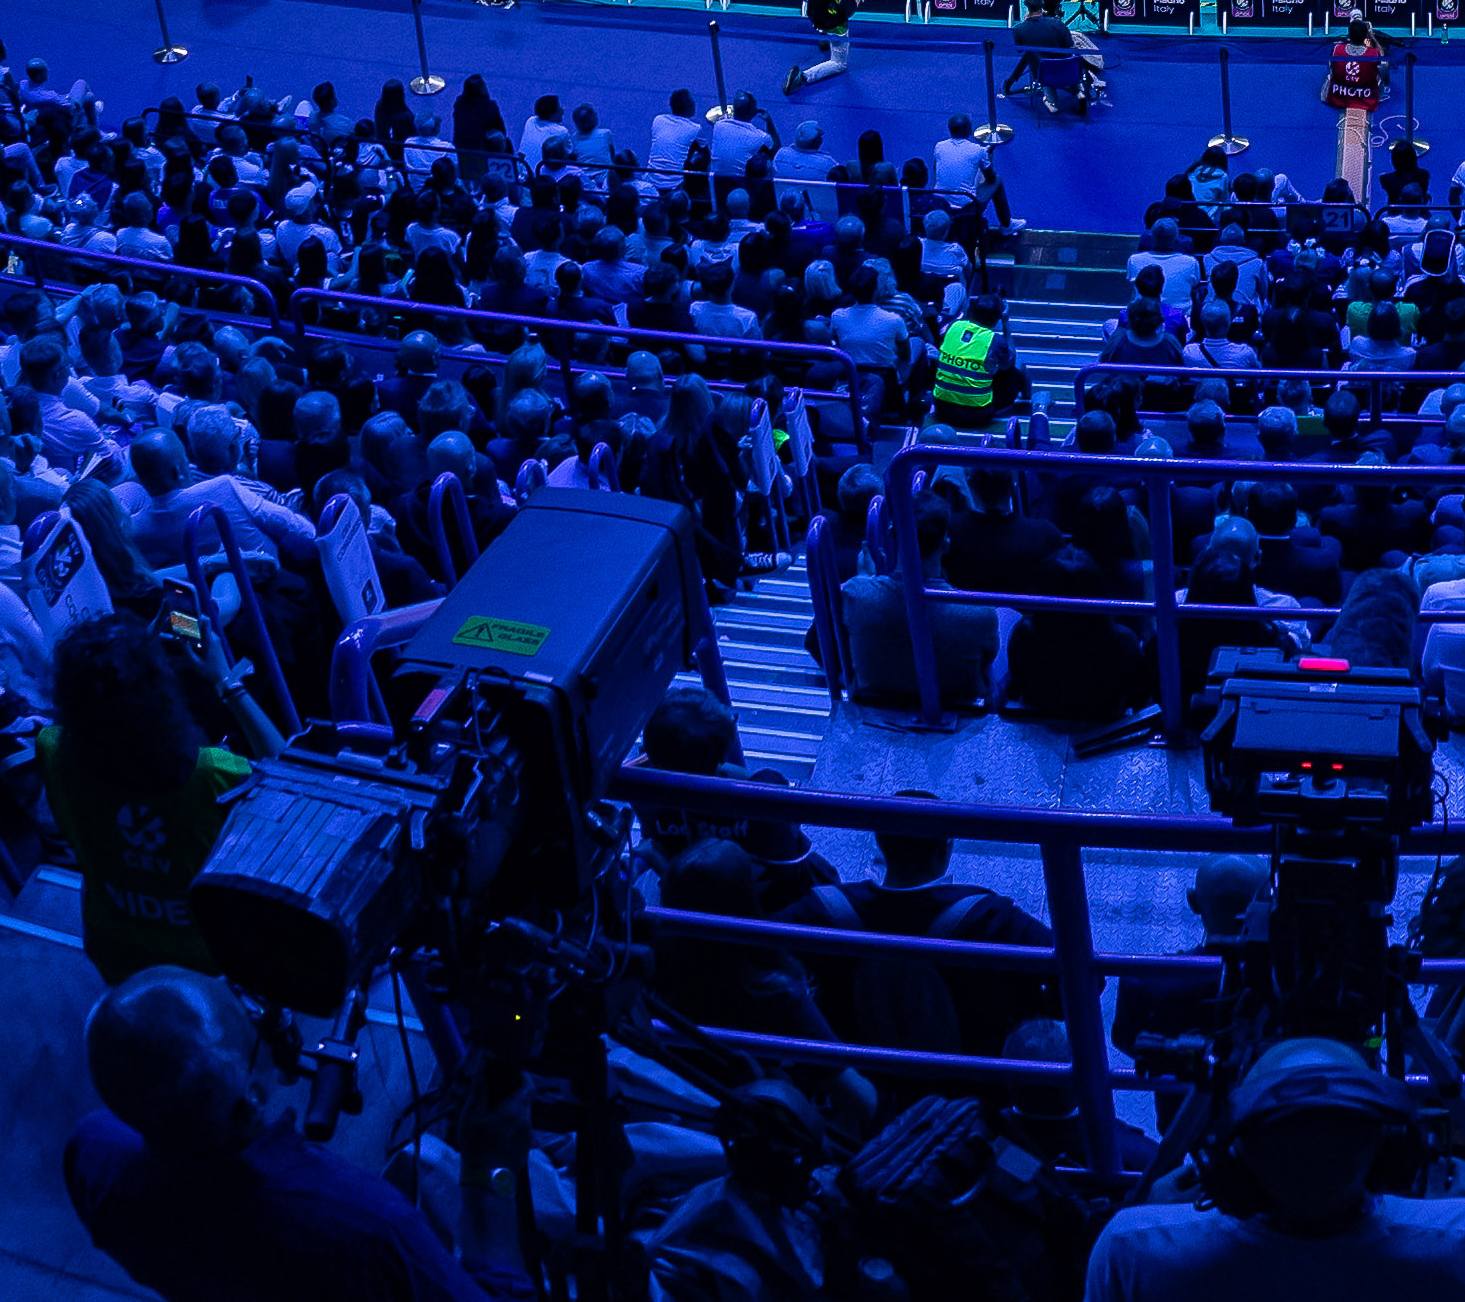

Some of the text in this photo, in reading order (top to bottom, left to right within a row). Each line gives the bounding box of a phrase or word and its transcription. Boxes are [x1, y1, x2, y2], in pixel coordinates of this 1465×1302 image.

[1375, 3, 1396, 16] Italy
[1331, 86, 1372, 100] PHOTO
[1325, 209, 1352, 227] 21
[942, 356, 981, 371] PHOTO
[108, 884, 189, 925] VIDE
